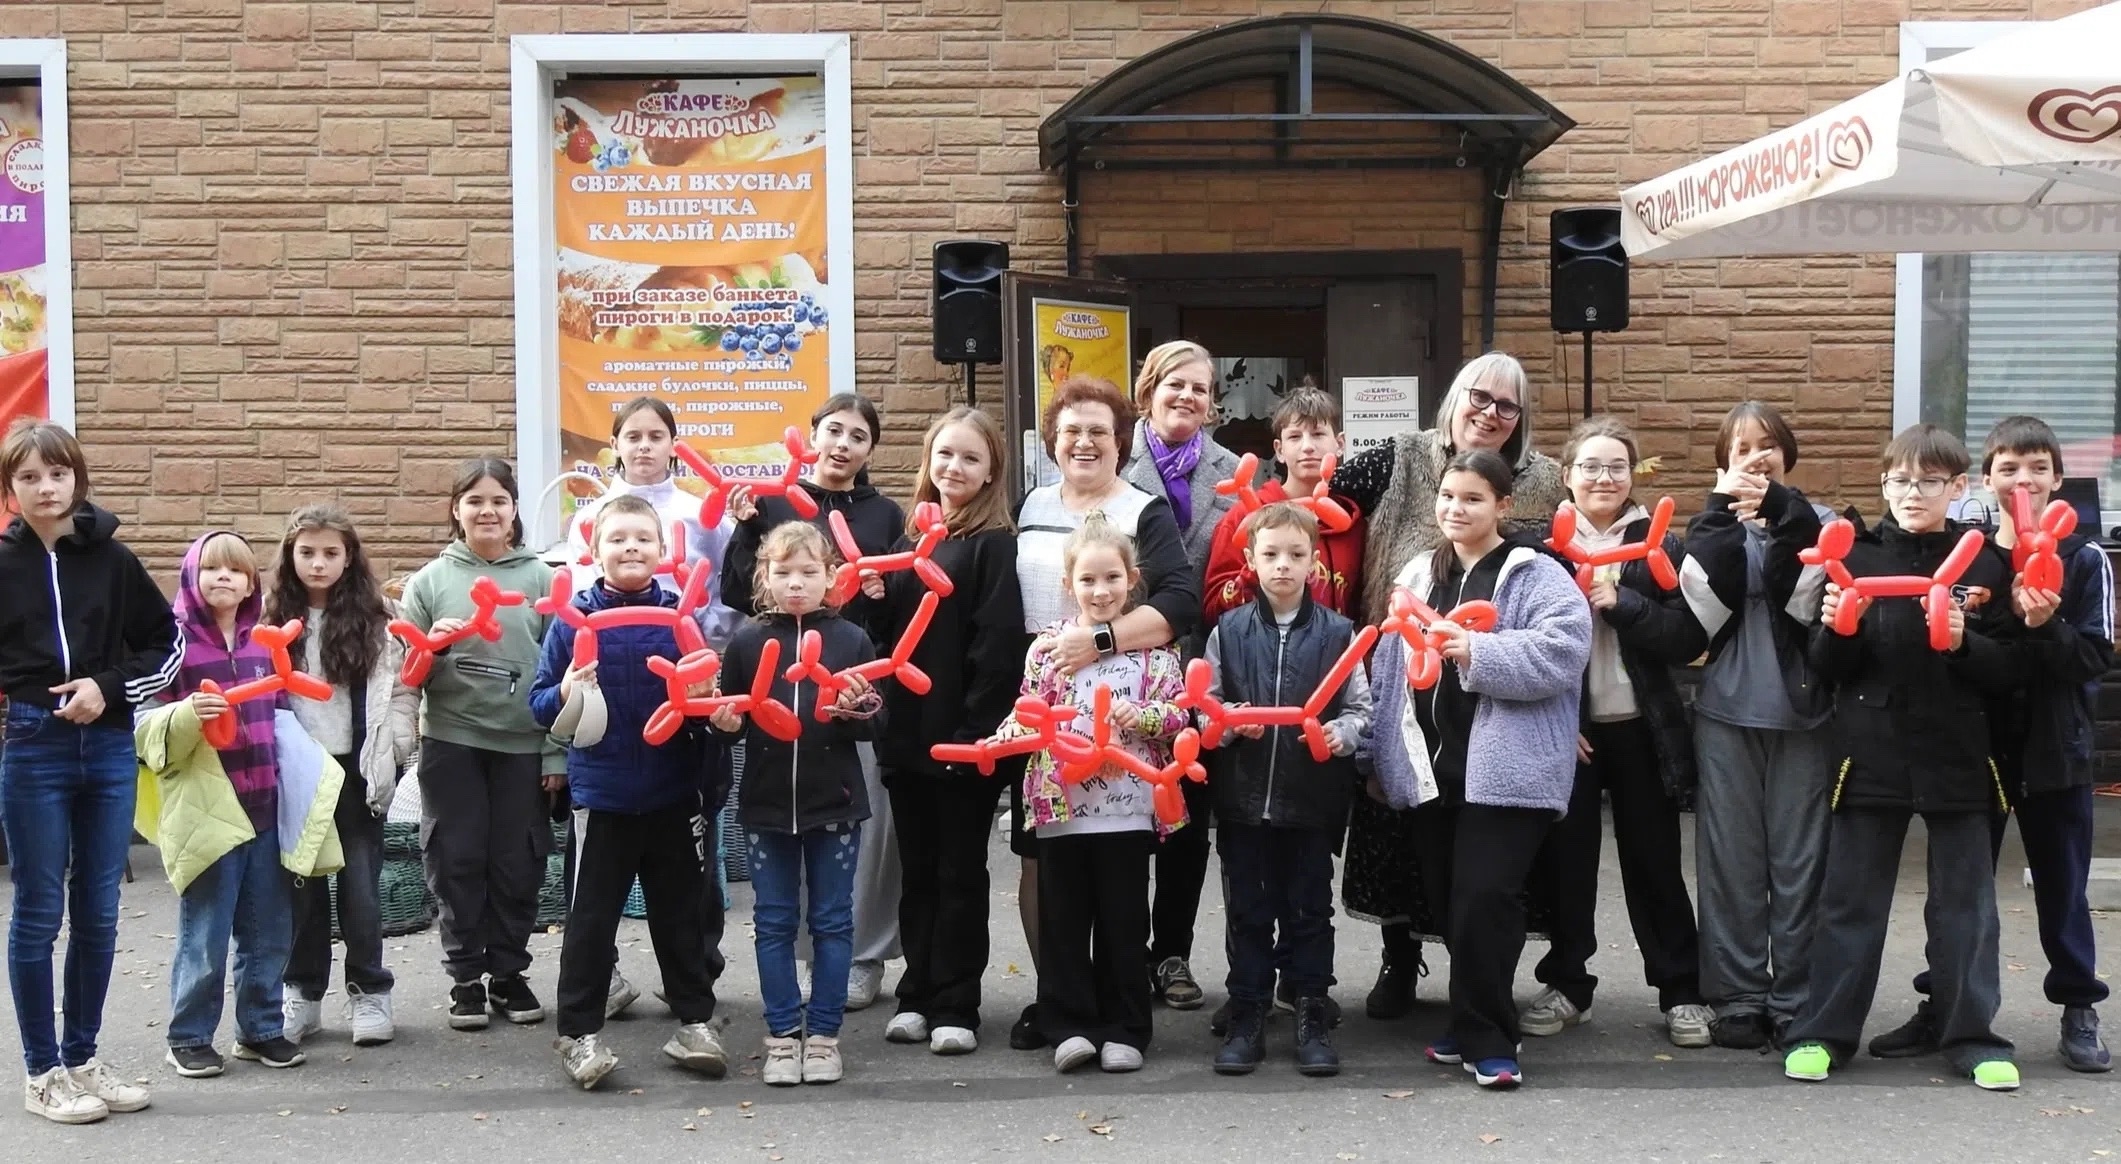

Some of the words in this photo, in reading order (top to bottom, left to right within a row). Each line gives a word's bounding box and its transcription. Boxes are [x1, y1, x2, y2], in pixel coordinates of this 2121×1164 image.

[663, 94, 722, 112] КАФЕ
[611, 110, 775, 139] ЛУЖАНОЧКА
[570, 174, 681, 192] СВЕЖАЯ
[688, 172, 813, 191] ВКУСНАЯ
[626, 199, 757, 216] ВЫПЕЧКА
[588, 220, 715, 241] КАЖДЫЙ
[720, 222, 797, 242] ДЕНЬ!
[592, 290, 633, 306] при
[638, 289, 707, 302] заказе
[713, 285, 798, 302] банкета
[598, 312, 673, 327] пироги
[680, 312, 692, 324] в
[698, 308, 793, 328] подарок!
[1071, 314, 1092, 324] КАФЕ
[604, 359, 699, 374] ароматные
[704, 357, 790, 372] пирожки,
[587, 380, 656, 393] сладкие
[661, 376, 739, 395] булочки,
[744, 379, 807, 394] пиццы,
[686, 400, 784, 415] пирожные,
[676, 423, 734, 437] ИРОГИ
[1353, 438, 1388, 447] 8.00-2
